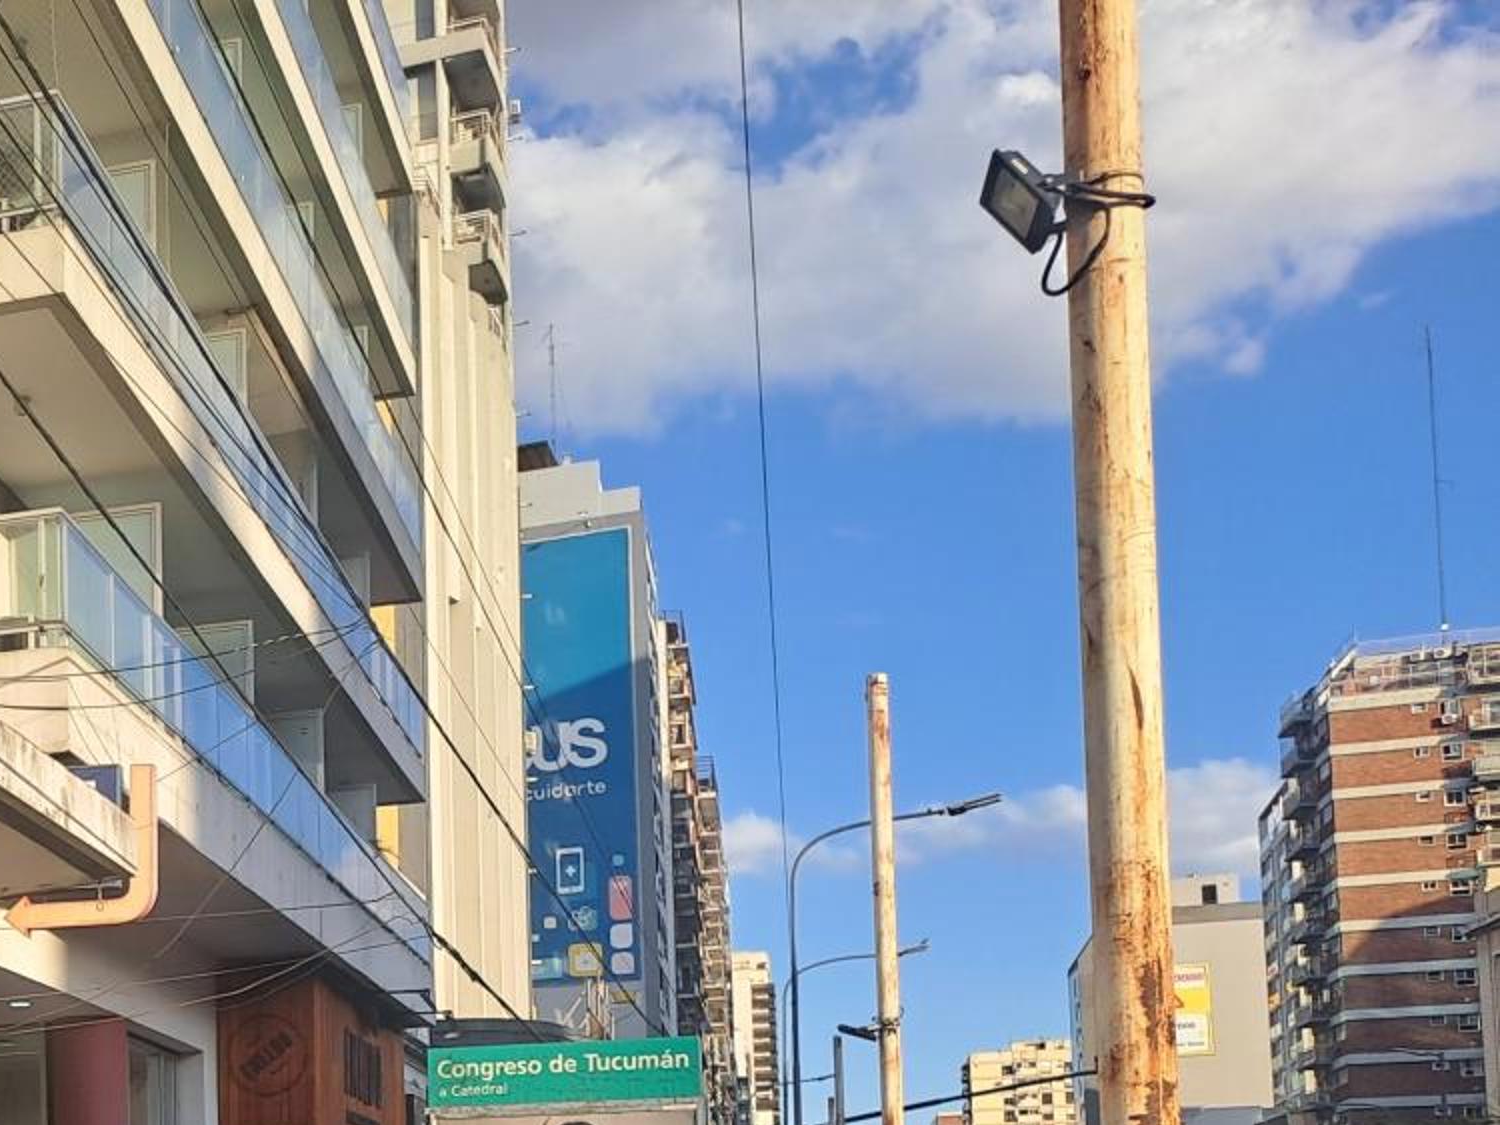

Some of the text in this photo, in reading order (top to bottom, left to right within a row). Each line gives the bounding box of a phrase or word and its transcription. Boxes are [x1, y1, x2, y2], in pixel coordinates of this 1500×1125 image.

[436, 1049, 689, 1081] Congreso de Tucumán
[451, 1084, 508, 1097] Catedral
